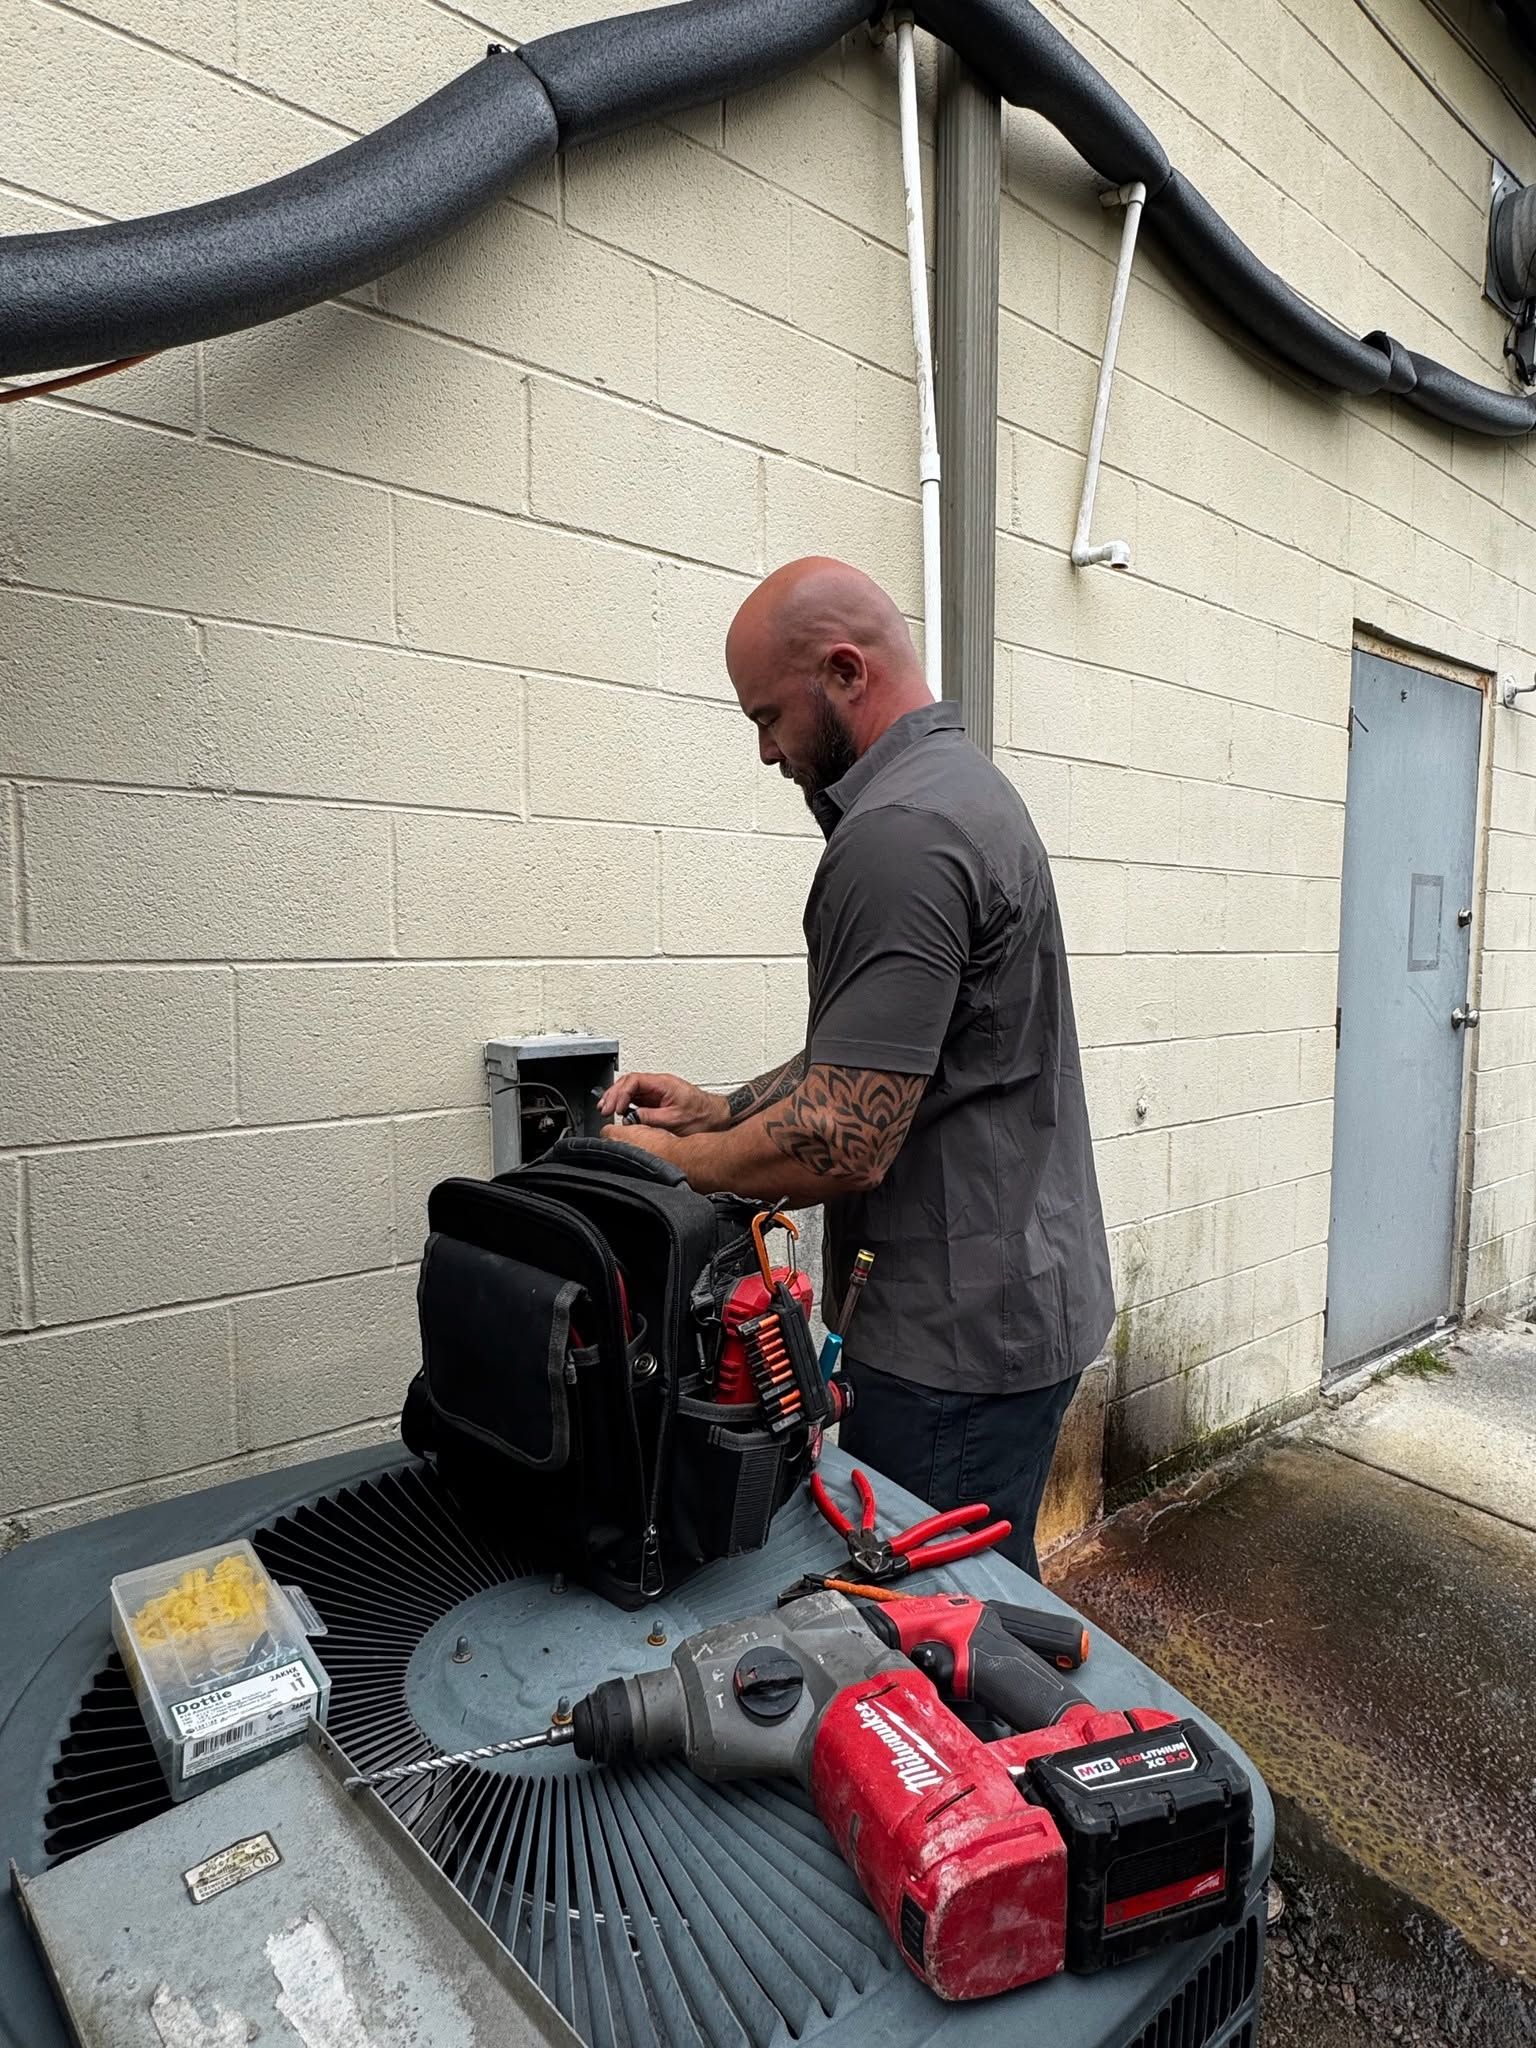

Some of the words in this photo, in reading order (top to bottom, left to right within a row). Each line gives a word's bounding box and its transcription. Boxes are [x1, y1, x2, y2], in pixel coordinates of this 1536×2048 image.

[269, 1666, 298, 1682] 2AKHX
[175, 1691, 232, 1715] Dottie
[854, 1701, 944, 1796] Milwaukee
[1117, 1742, 1187, 1766] REDLITHIUM
[1077, 1761, 1115, 1778] M18
[1146, 1750, 1190, 1769] XC5.0
